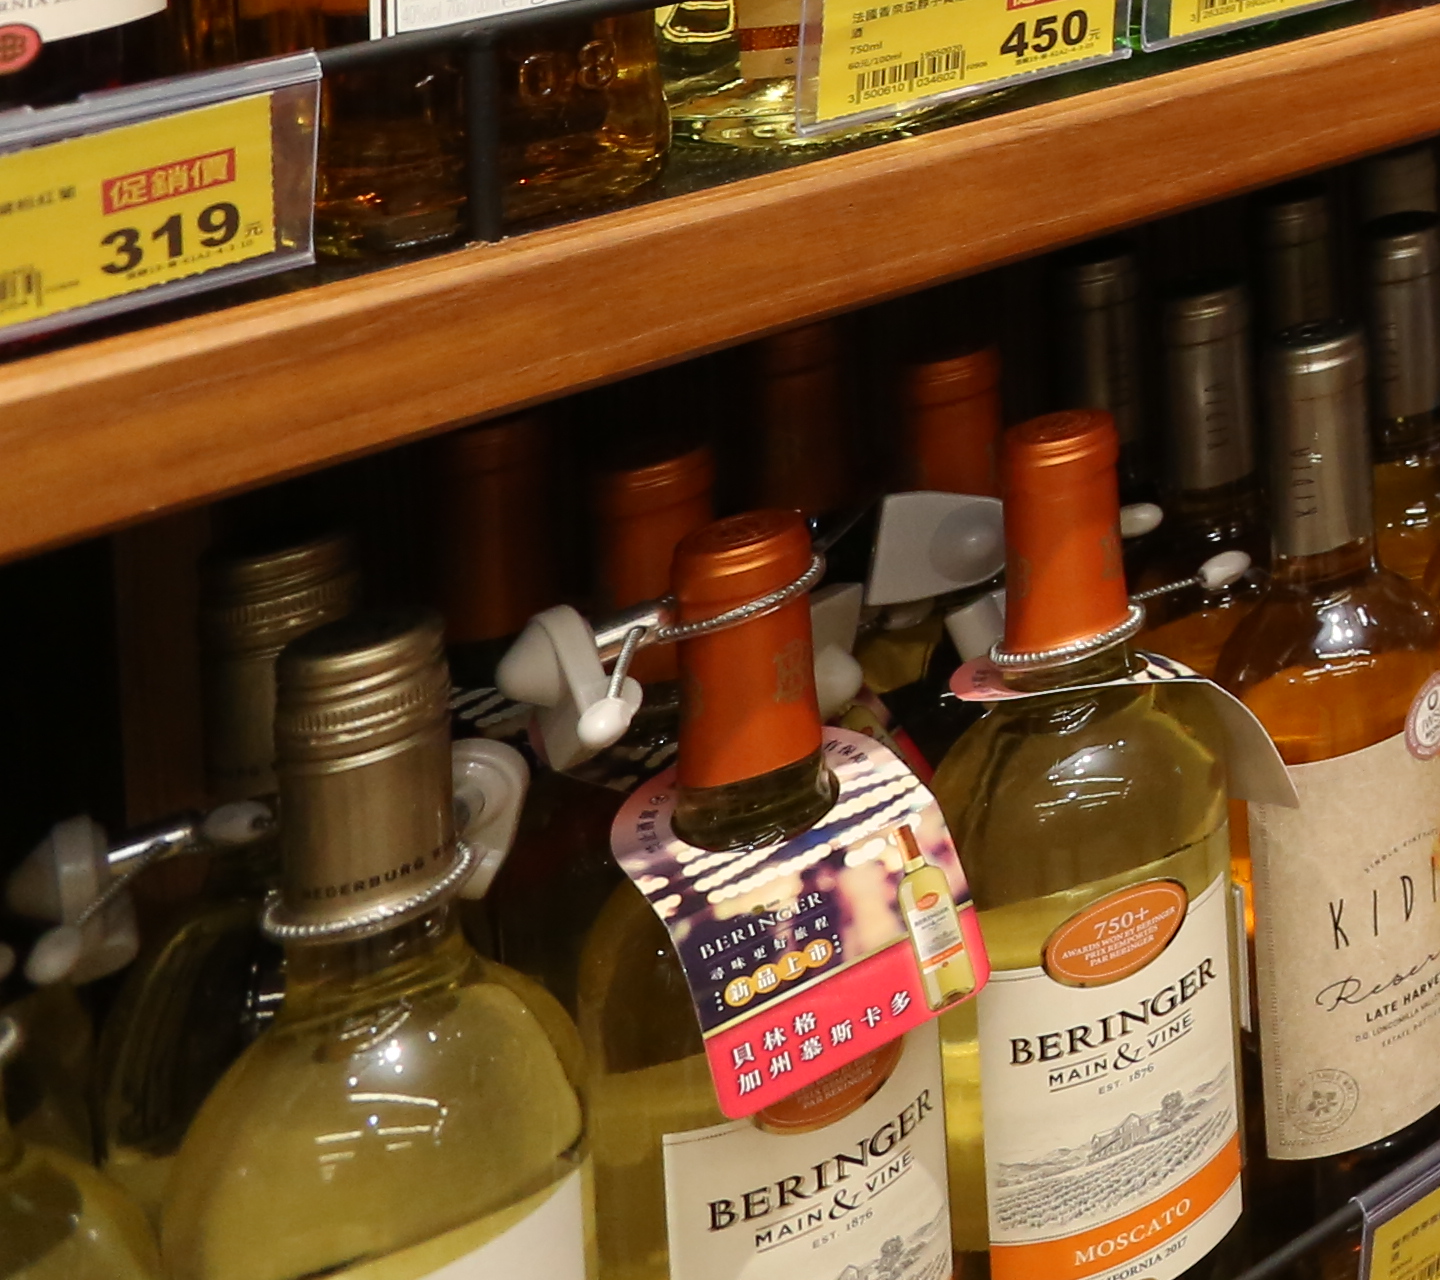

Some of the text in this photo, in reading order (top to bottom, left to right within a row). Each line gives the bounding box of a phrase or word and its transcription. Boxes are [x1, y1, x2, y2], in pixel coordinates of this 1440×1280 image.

[850, 40, 883, 55] 750ml
[1000, 9, 1088, 57] 450
[863, 70, 957, 102] 500610 034602
[109, 154, 229, 209] 促銷價
[100, 201, 241, 275] 319
[699, 891, 824, 960] BERINGER
[1061, 906, 1176, 959] AWARDS WON BY BERINGER
[1093, 906, 1150, 940] 750+
[728, 942, 828, 1003] 新品上市
[1084, 947, 1107, 960] PRIX
[1090, 935, 1156, 968] PAR BERINGER
[1009, 957, 1217, 1067] BERINGER
[1365, 999, 1398, 1023] LATE
[732, 1011, 817, 1070] 貝林格
[737, 990, 912, 1097] 加州慕斯卡多
[1049, 1012, 1195, 1087] MAIN & VINE
[1098, 1064, 1155, 1095] EST. 1876
[707, 1088, 934, 1233] BERINGER
[755, 1150, 914, 1248] MAIN & VINE
[812, 1210, 873, 1250] EST. 1876
[1073, 1197, 1192, 1267] MOSCATO
[1164, 1235, 1188, 1258] 2017
